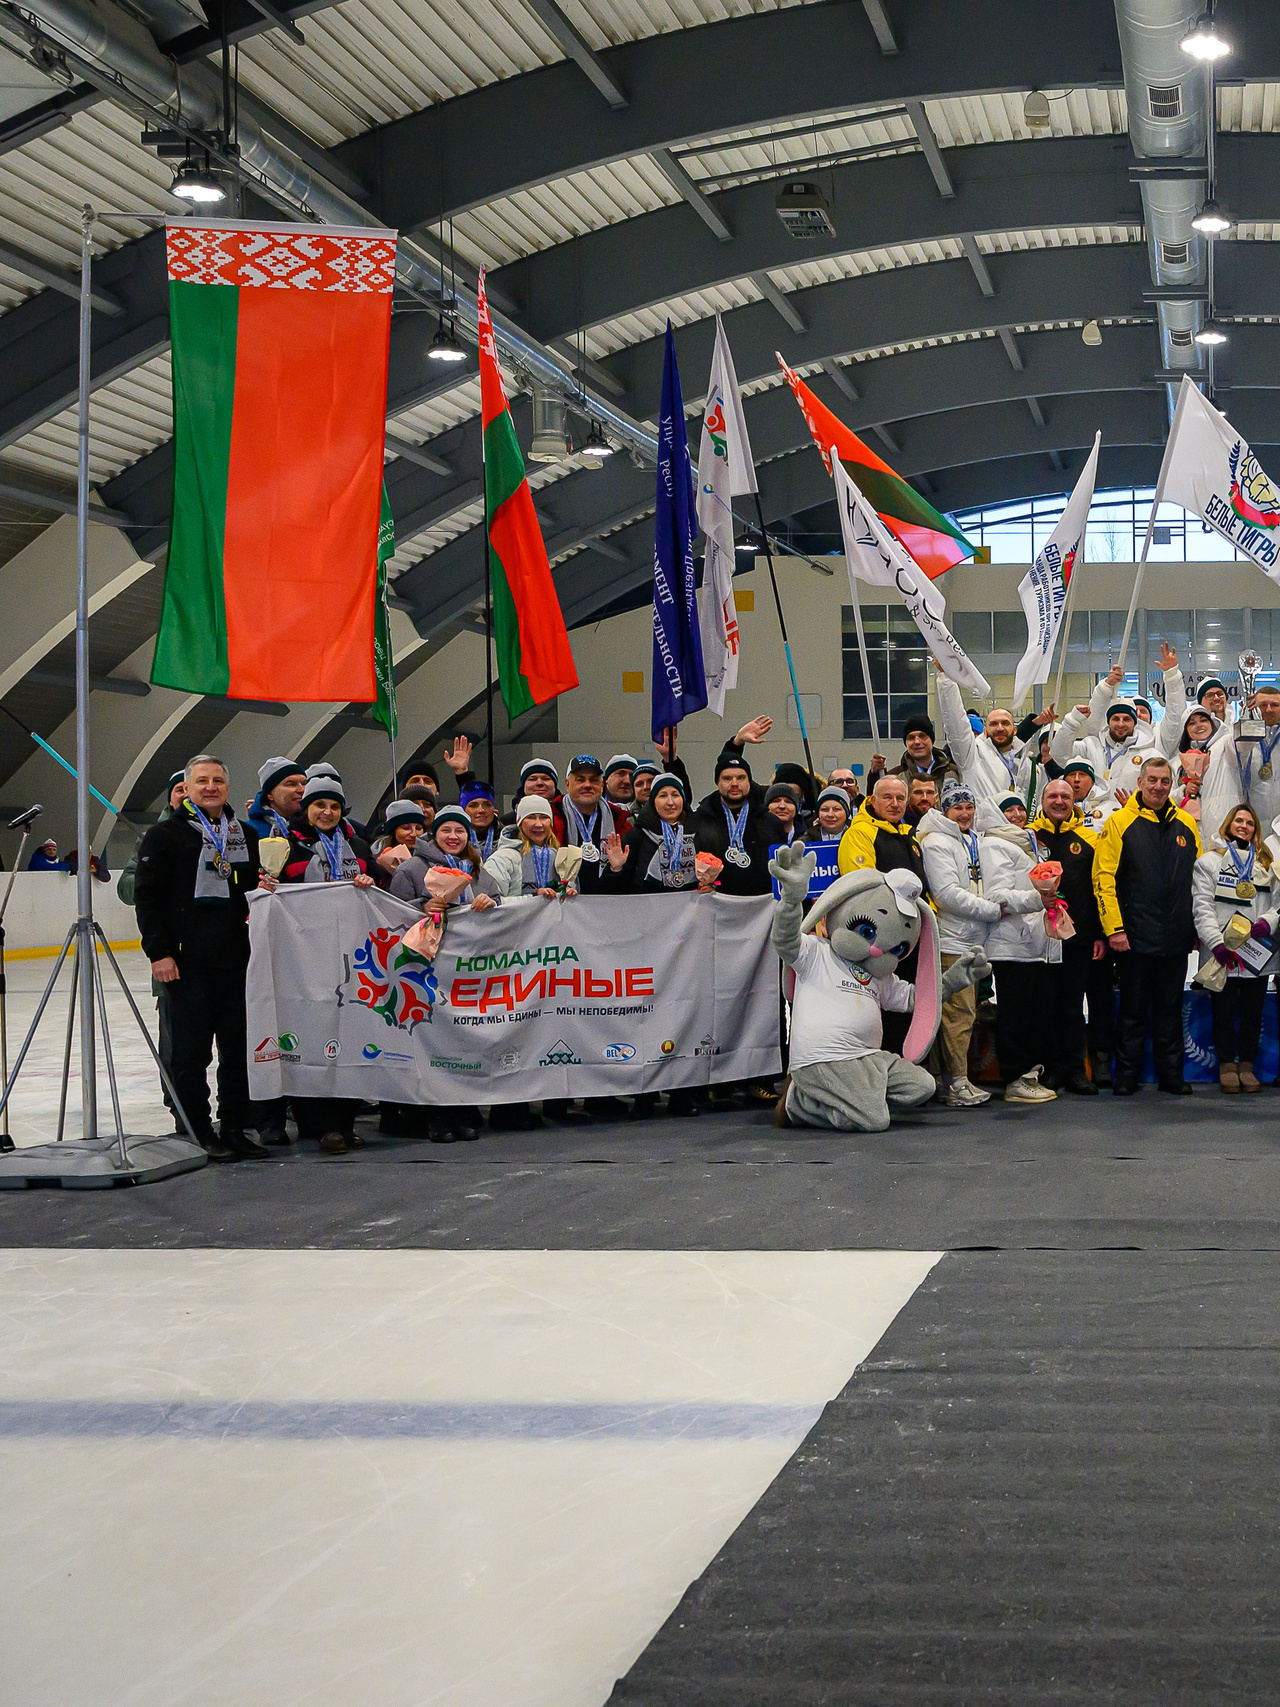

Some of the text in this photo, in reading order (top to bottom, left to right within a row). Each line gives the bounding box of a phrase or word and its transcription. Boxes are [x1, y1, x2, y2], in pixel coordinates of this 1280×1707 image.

[1205, 493, 1280, 567] БЕЛЫЕ ТИГРЫ
[456, 945, 580, 972] КОМАНДА
[450, 967, 655, 1014] ЕДИНЫЕ
[453, 1015, 485, 1027] КОГДА
[487, 1014, 506, 1025] МЫ
[508, 1008, 542, 1023] ЕДИНЫ
[556, 1006, 576, 1016] МЫ
[578, 1004, 655, 1017] НЕПОБЕДИМЫ!
[430, 1060, 482, 1070] ВОСТОЧНЫЙ
